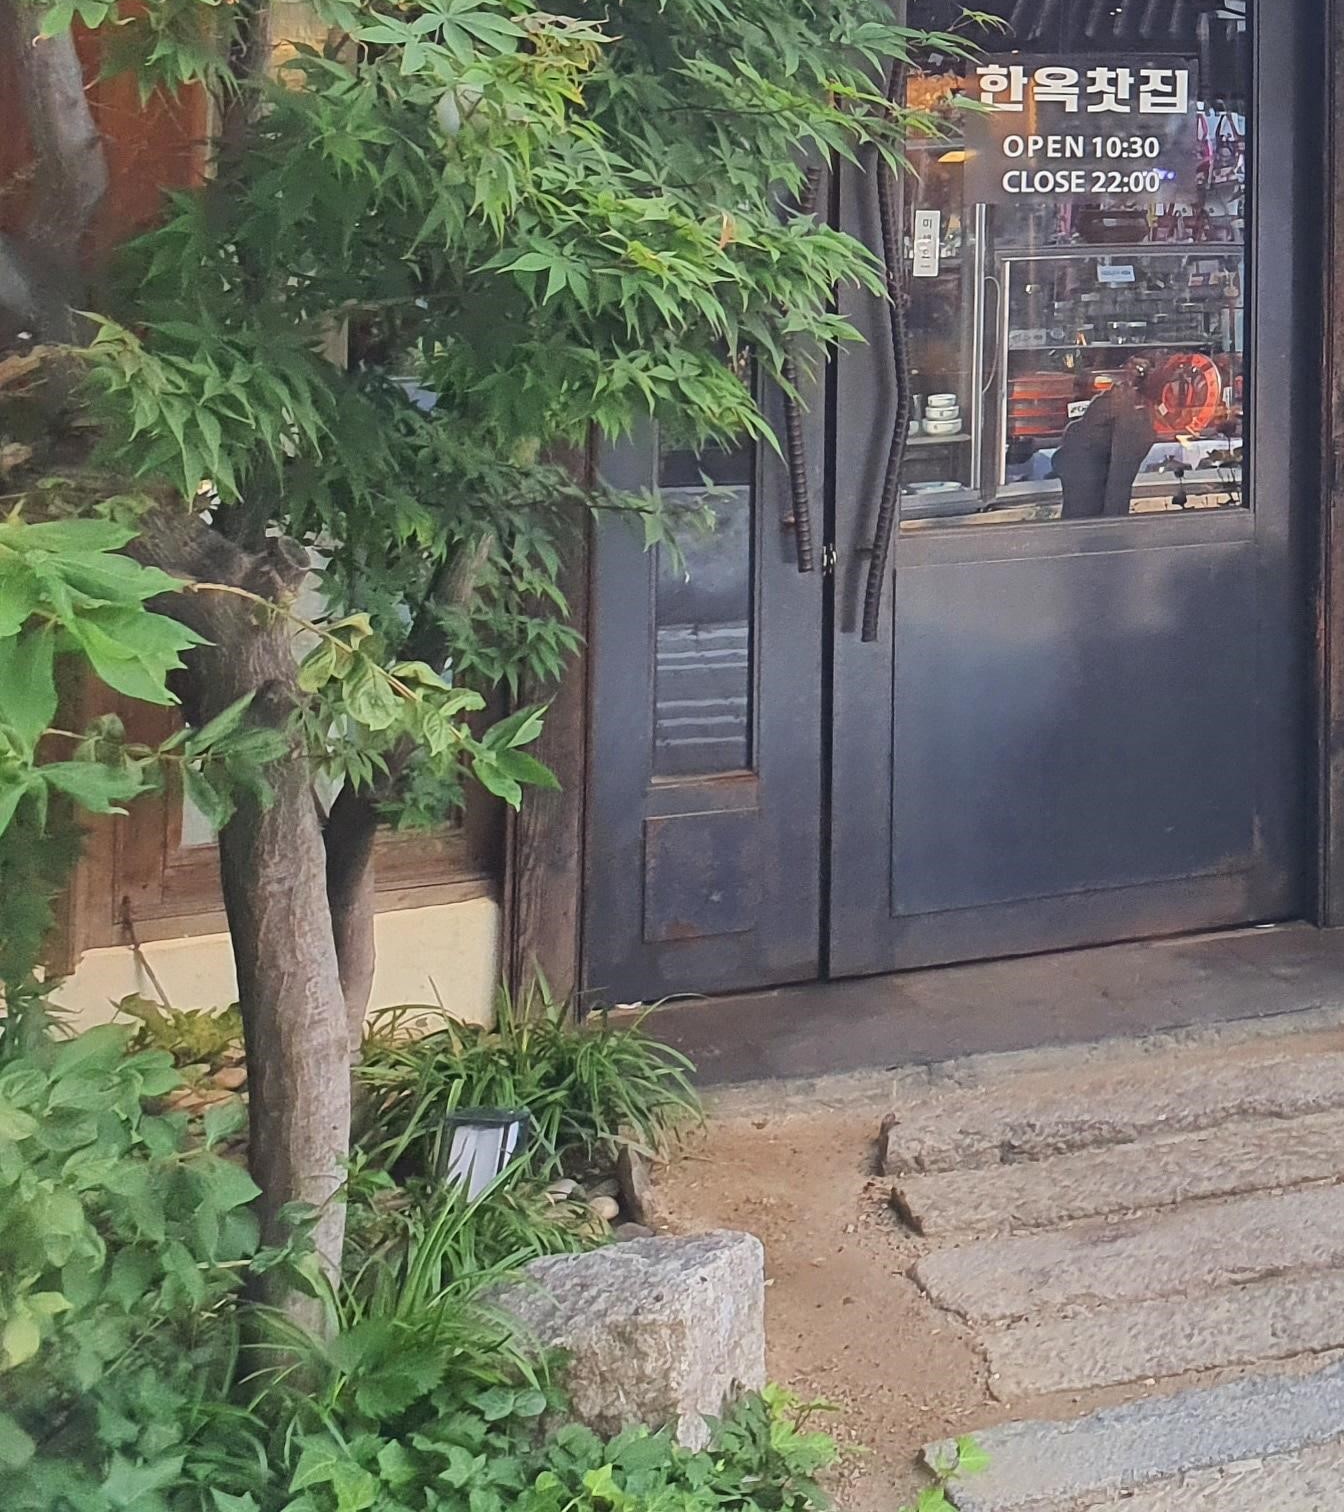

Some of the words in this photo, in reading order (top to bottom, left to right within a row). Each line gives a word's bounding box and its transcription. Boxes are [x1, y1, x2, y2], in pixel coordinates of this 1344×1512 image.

[976, 64, 1189, 113] 한옥찻집
[1002, 135, 1084, 158] OPEN
[1091, 136, 1160, 159] 10:30
[1002, 170, 1085, 193] CLOSE
[1091, 171, 1160, 193] 22:00
